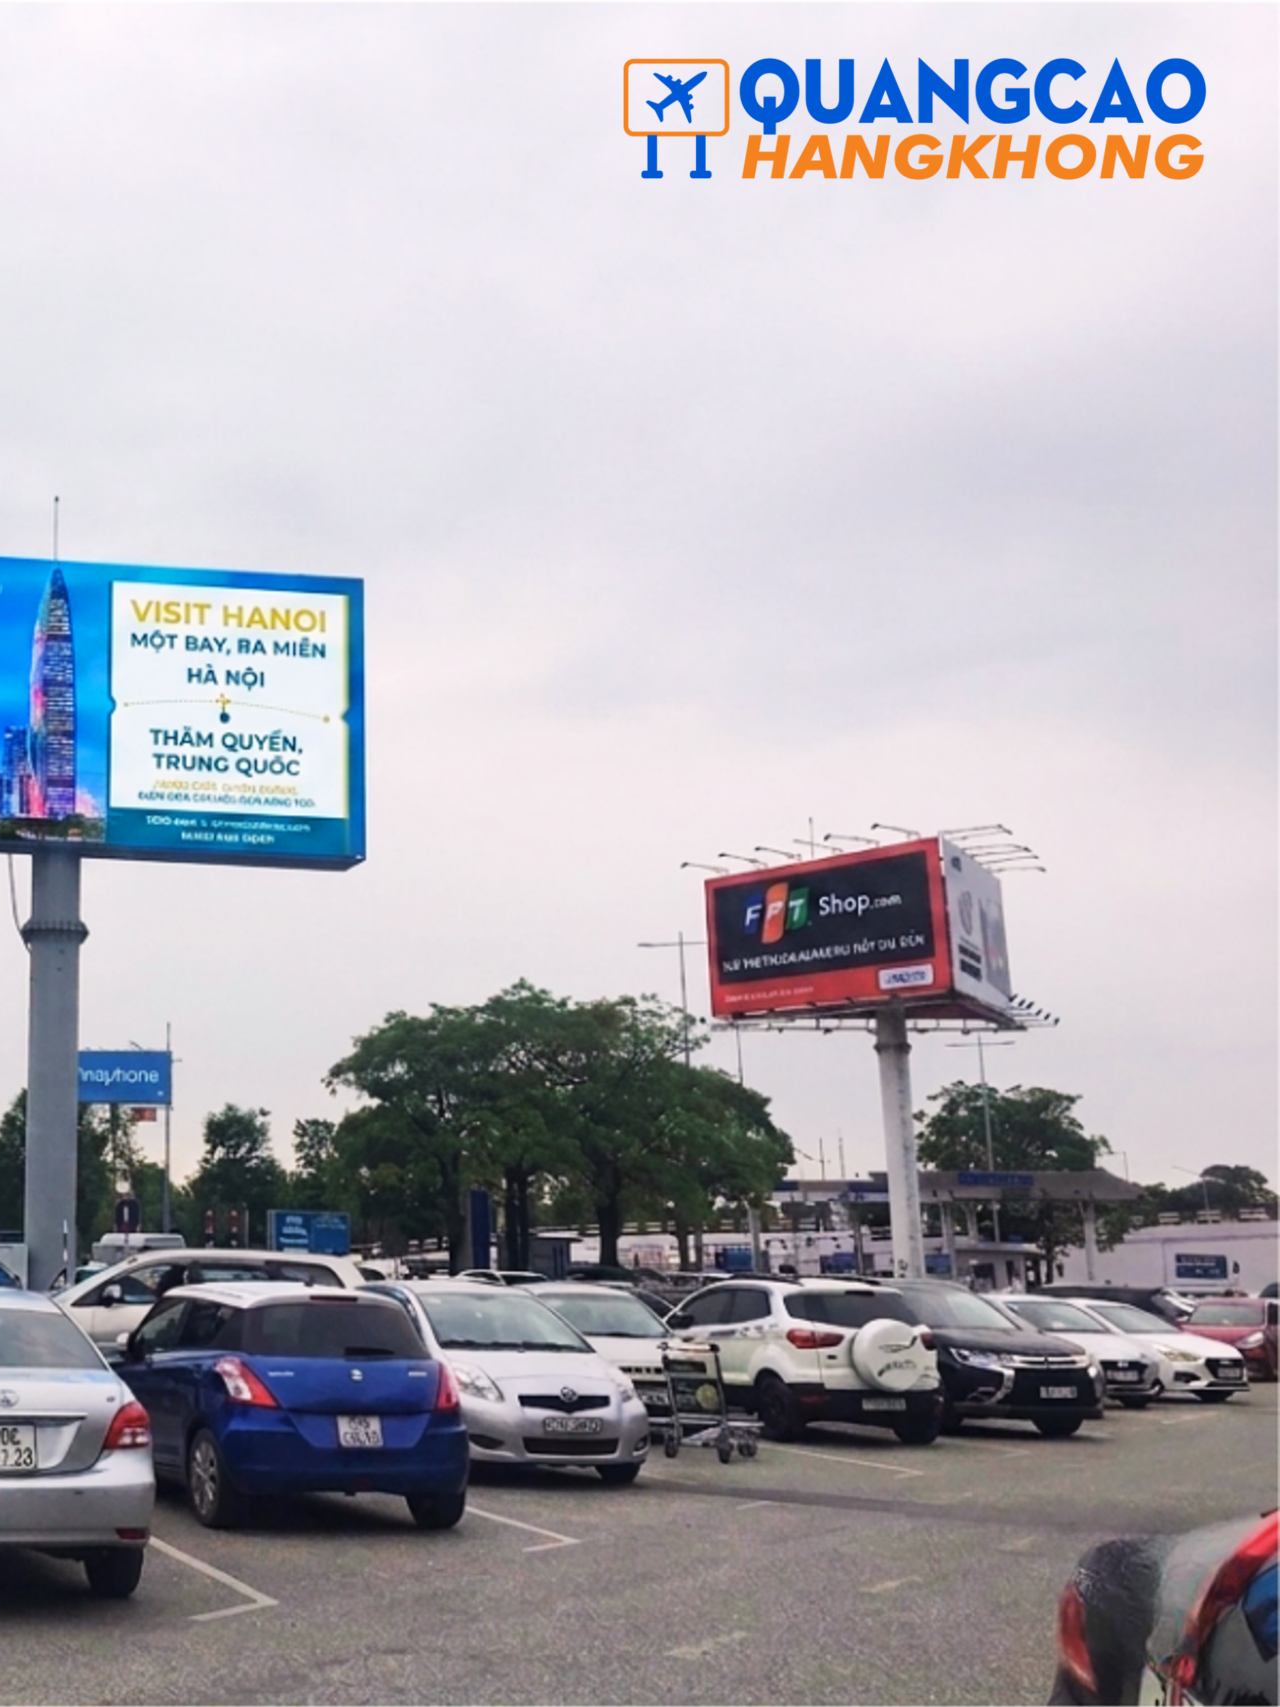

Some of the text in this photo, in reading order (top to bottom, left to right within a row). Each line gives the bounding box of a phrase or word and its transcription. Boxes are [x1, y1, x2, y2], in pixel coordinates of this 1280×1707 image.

[130, 599, 326, 633] VISIT HANOI
[184, 635, 232, 656] BAY,
[187, 663, 265, 692] HÀ NỘI
[152, 753, 230, 773] TRUNG
